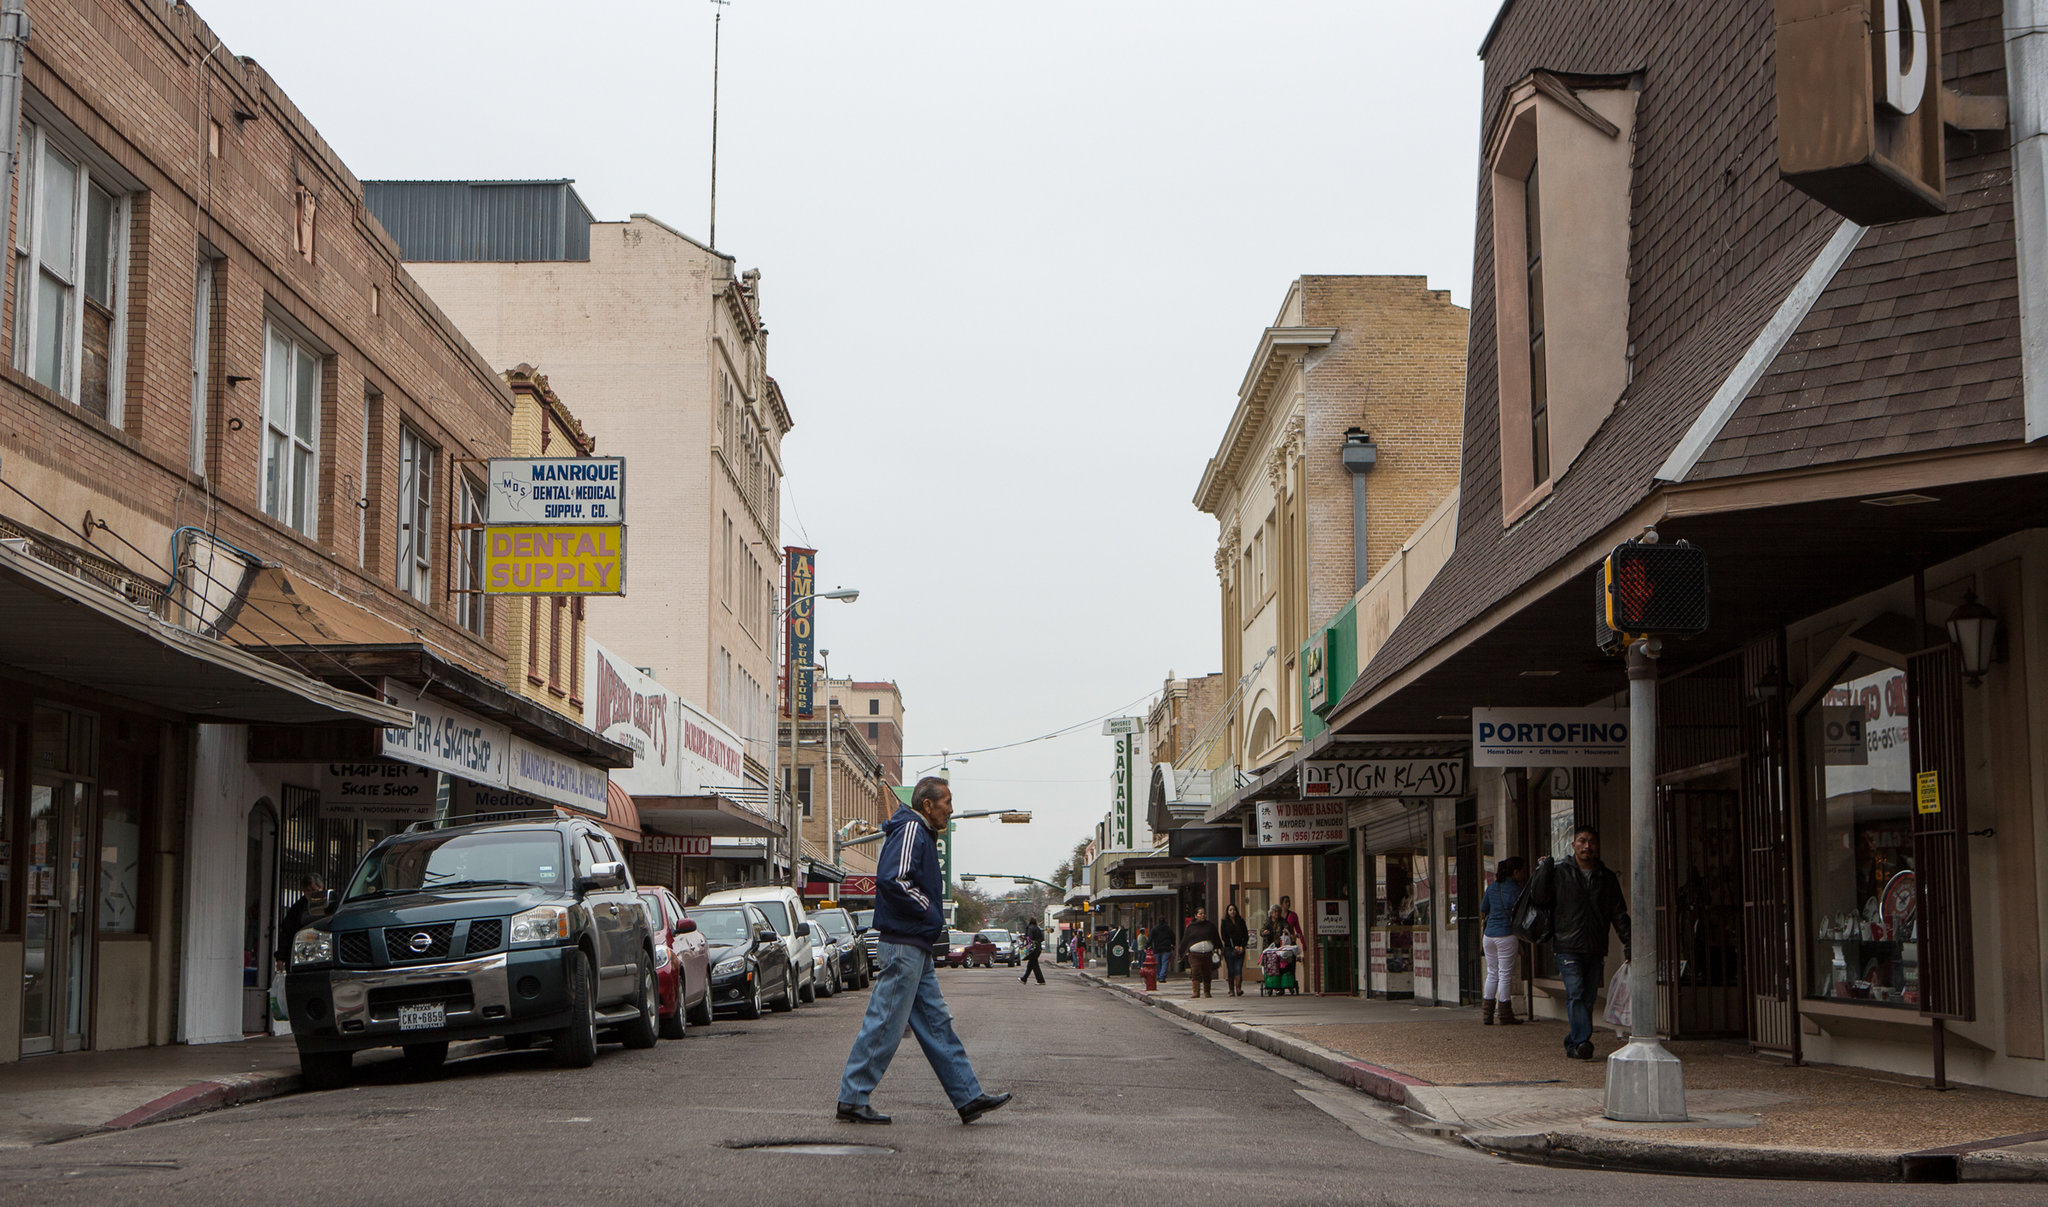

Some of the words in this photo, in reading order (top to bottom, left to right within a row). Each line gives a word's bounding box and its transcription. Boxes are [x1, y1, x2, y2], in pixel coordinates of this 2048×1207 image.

[532, 464, 618, 482] MANRIQUE
[533, 486, 571, 500] DENTAL
[575, 486, 616, 500] MEDICAL
[591, 504, 608, 518] CO.
[492, 532, 615, 557] DENTAL
[491, 562, 615, 588] SUPPLY
[793, 555, 812, 639] AMCO
[595, 649, 632, 734] IMPERIO
[433, 716, 443, 757] 4
[1479, 722, 1628, 743] PORTOFINO
[520, 748, 555, 787] MANRIQUE
[556, 762, 578, 794] DENTAL
[1305, 762, 1385, 795] DESIGN
[1394, 762, 1460, 795] KLASS
[341, 782, 380, 796] SKATE
[383, 783, 418, 796] SHOP
[1116, 740, 1125, 845] SAVANNA
[475, 792, 535, 806] Medico
[363, 806, 409, 814] PHOTOGRAPHY
[1276, 805, 1283, 816] W
[1285, 804, 1291, 816] D
[1293, 803, 1314, 816] HOME
[1316, 802, 1344, 815] BASICS
[1279, 819, 1305, 829] MAYOREO
[1316, 818, 1343, 827] MENUDEO
[1281, 832, 1289, 841] Ph
[1292, 830, 1310, 842] (956)
[1312, 829, 1343, 840] 727-5888
